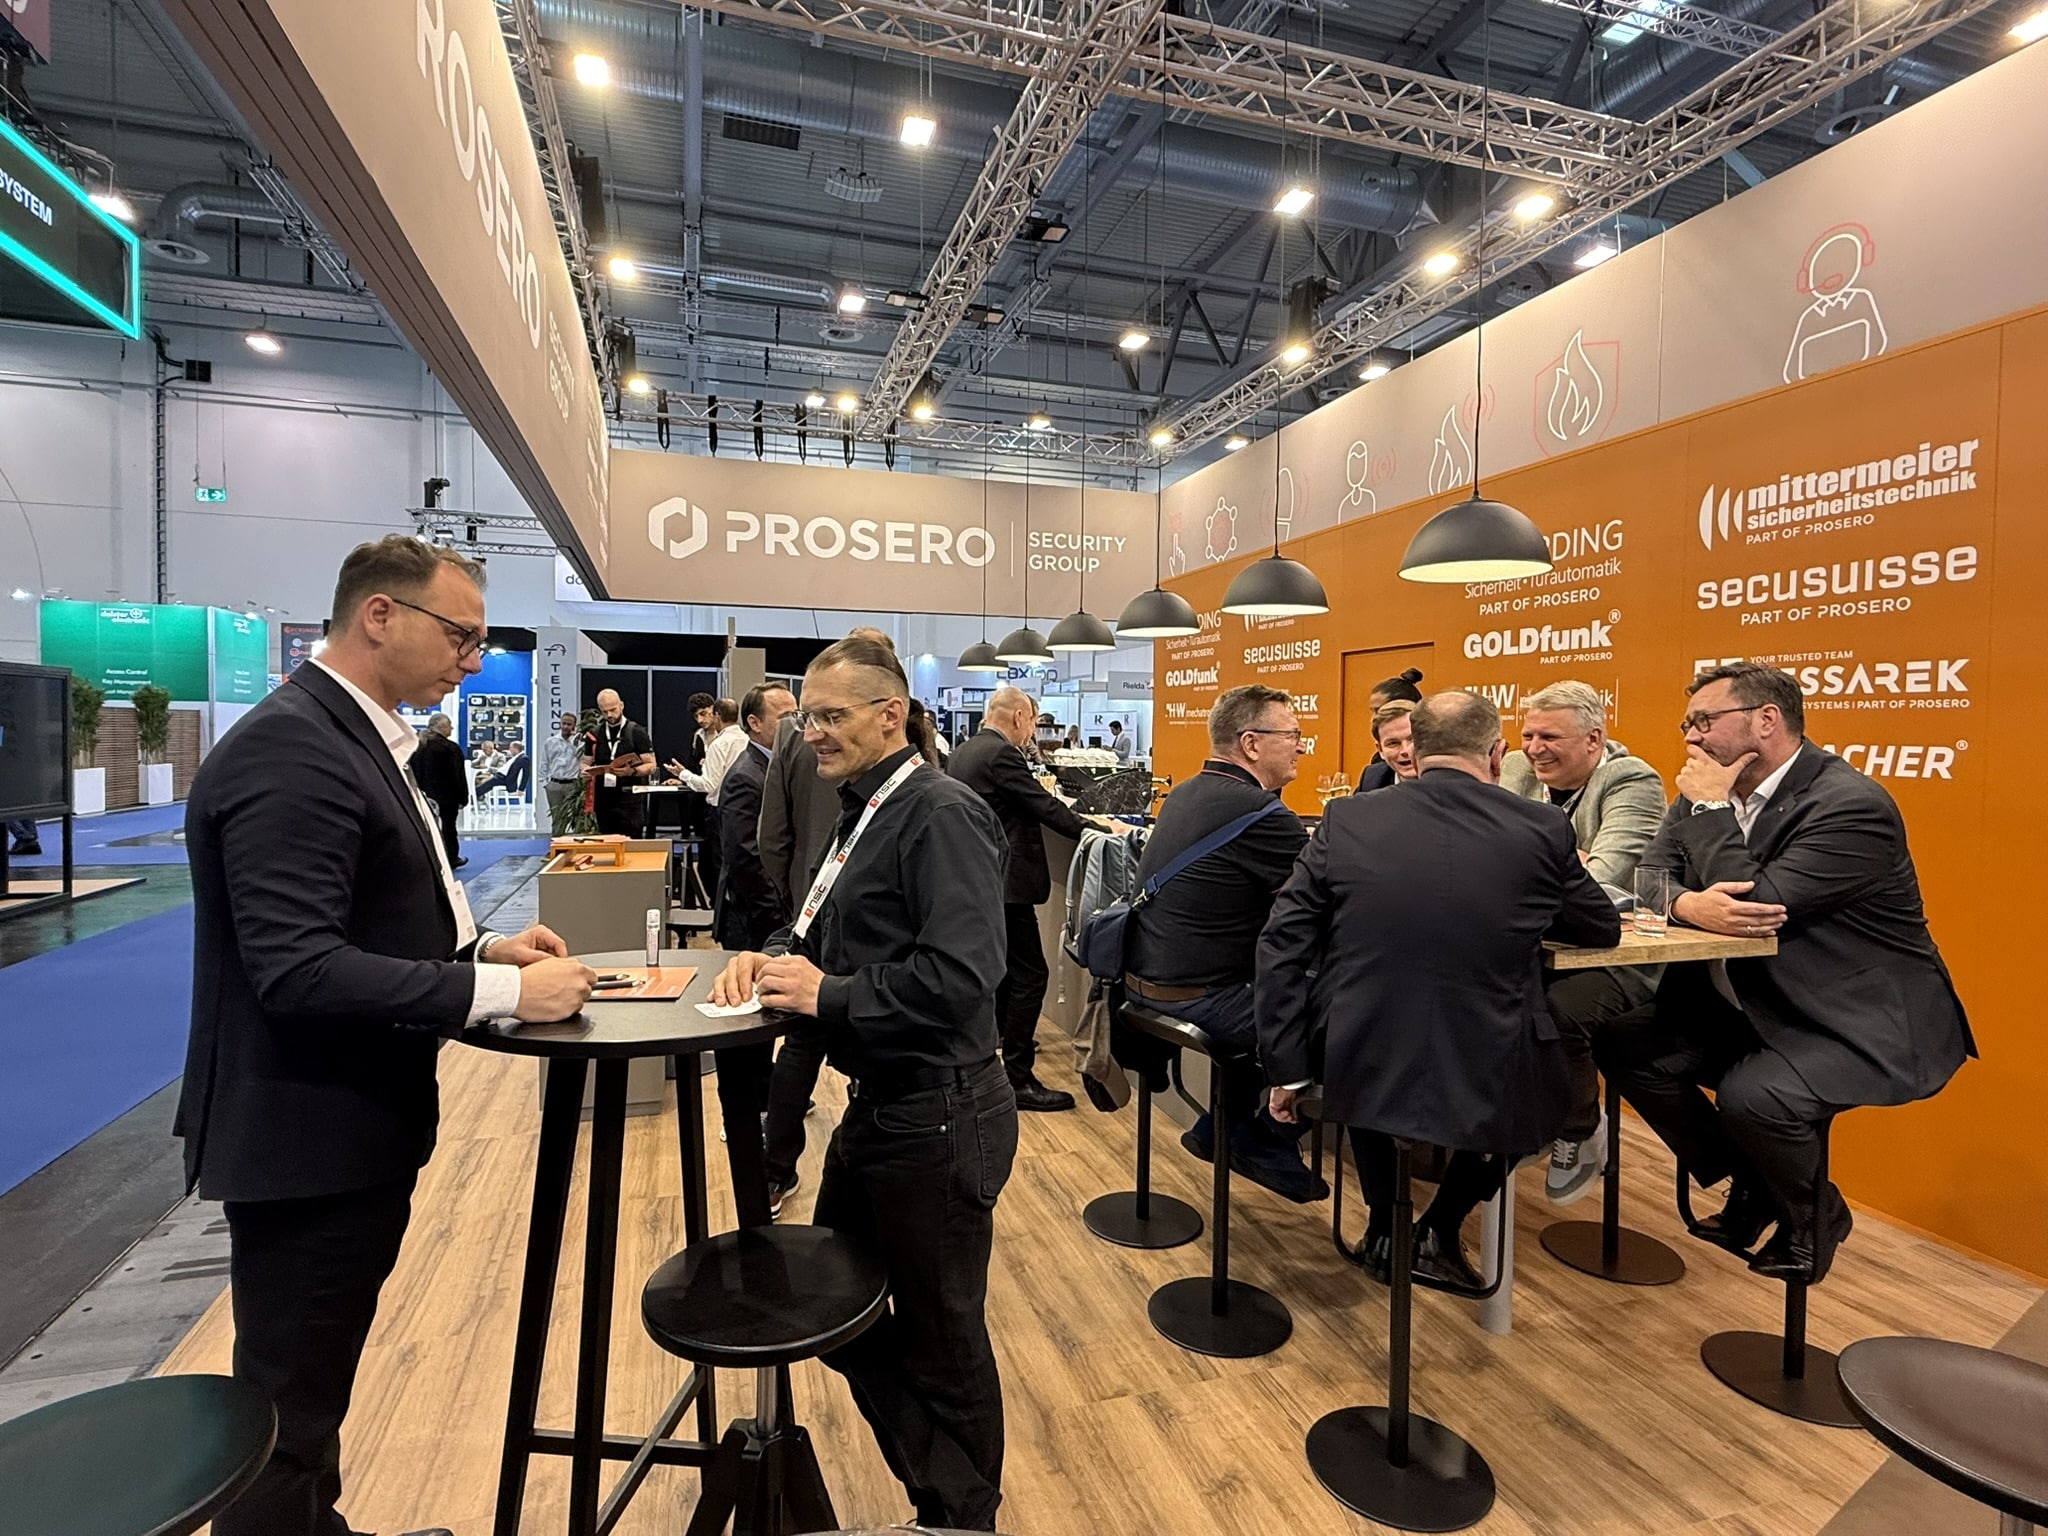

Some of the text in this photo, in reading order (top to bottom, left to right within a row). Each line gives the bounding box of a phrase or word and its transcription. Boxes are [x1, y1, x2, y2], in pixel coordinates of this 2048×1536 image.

[1747, 438, 1980, 511] mittermeier
[1747, 470, 1978, 531] sicherheitstechnik
[726, 510, 996, 568] PROSERO
[1028, 531, 1127, 553] SECURITY
[1542, 519, 1624, 562] DING
[1746, 513, 1875, 545] PART OF PROSERO
[1028, 554, 1101, 573] GROUP
[1697, 545, 1978, 610] secusuisse
[1479, 587, 1600, 616] PART OF PROSERO
[1740, 596, 1912, 626] PART OF PROSERO
[1243, 639, 1321, 665] secusuisse
[1540, 651, 1613, 665] PART OF PROSERO
[1750, 650, 1853, 664] YOUR TRUSTED TEAM
[551, 663, 562, 737] TECHNO
[1857, 700, 1886, 709] PART
[1889, 700, 1906, 709] OF
[1909, 699, 1971, 709] PROSERO
[808, 883, 828, 910] nsc
